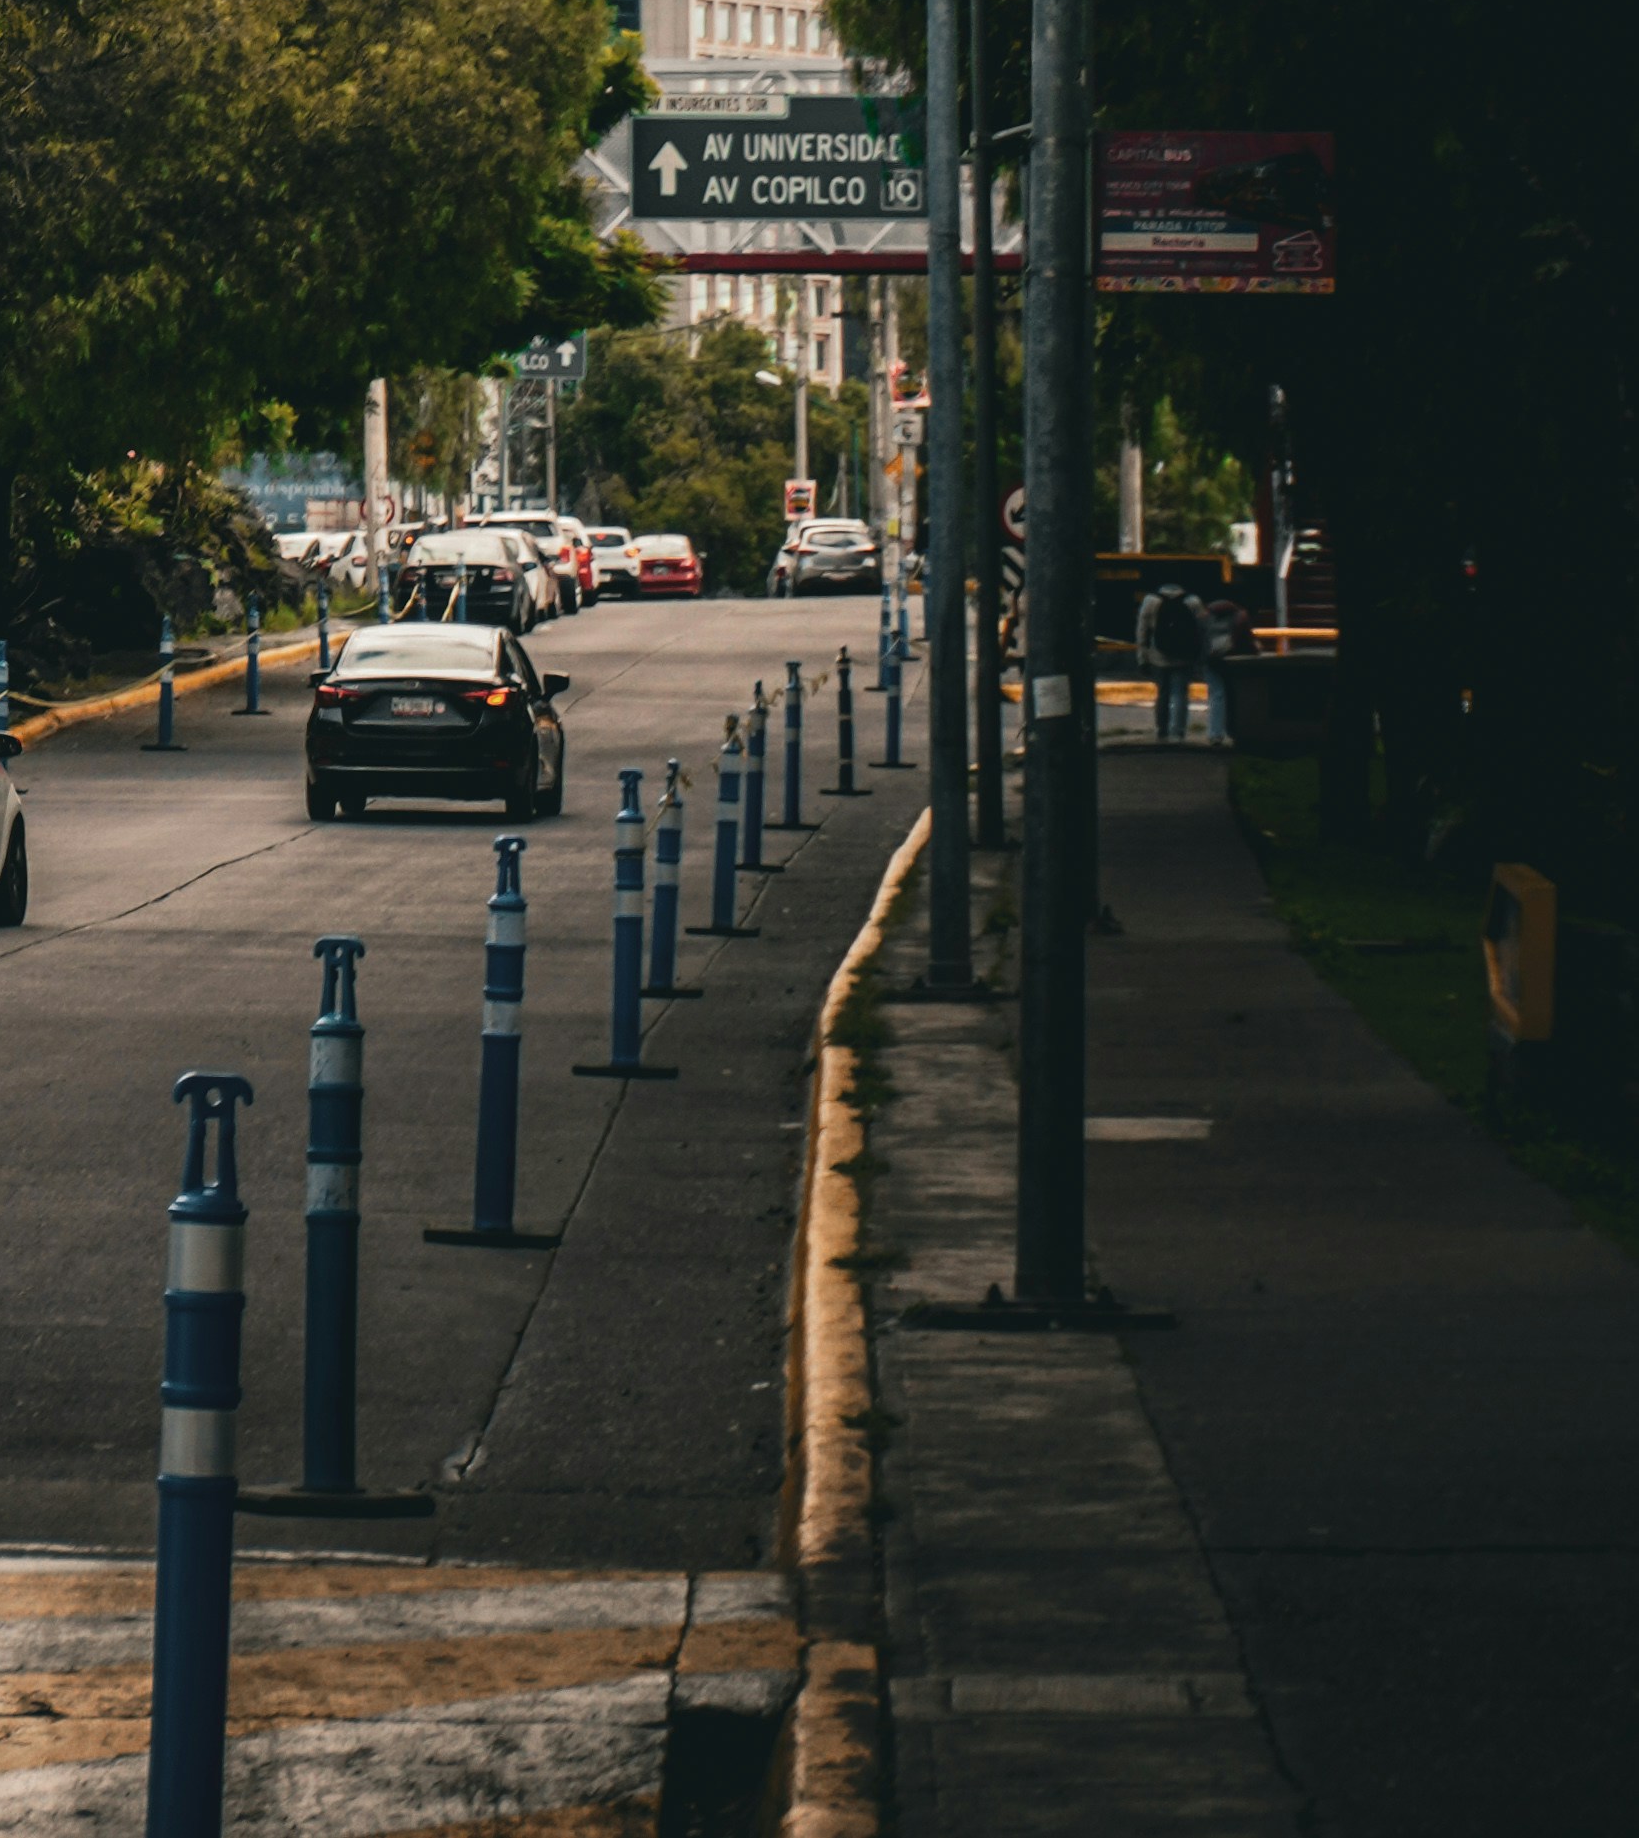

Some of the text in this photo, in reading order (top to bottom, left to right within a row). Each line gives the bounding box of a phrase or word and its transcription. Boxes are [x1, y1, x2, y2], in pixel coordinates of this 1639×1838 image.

[666, 96, 740, 111] INSURGENTES
[745, 96, 768, 112] SUR
[702, 132, 734, 161] AV
[702, 175, 866, 205] AV COPILCO
[1133, 221, 1183, 231] PARADA
[1194, 221, 1228, 231] STOP
